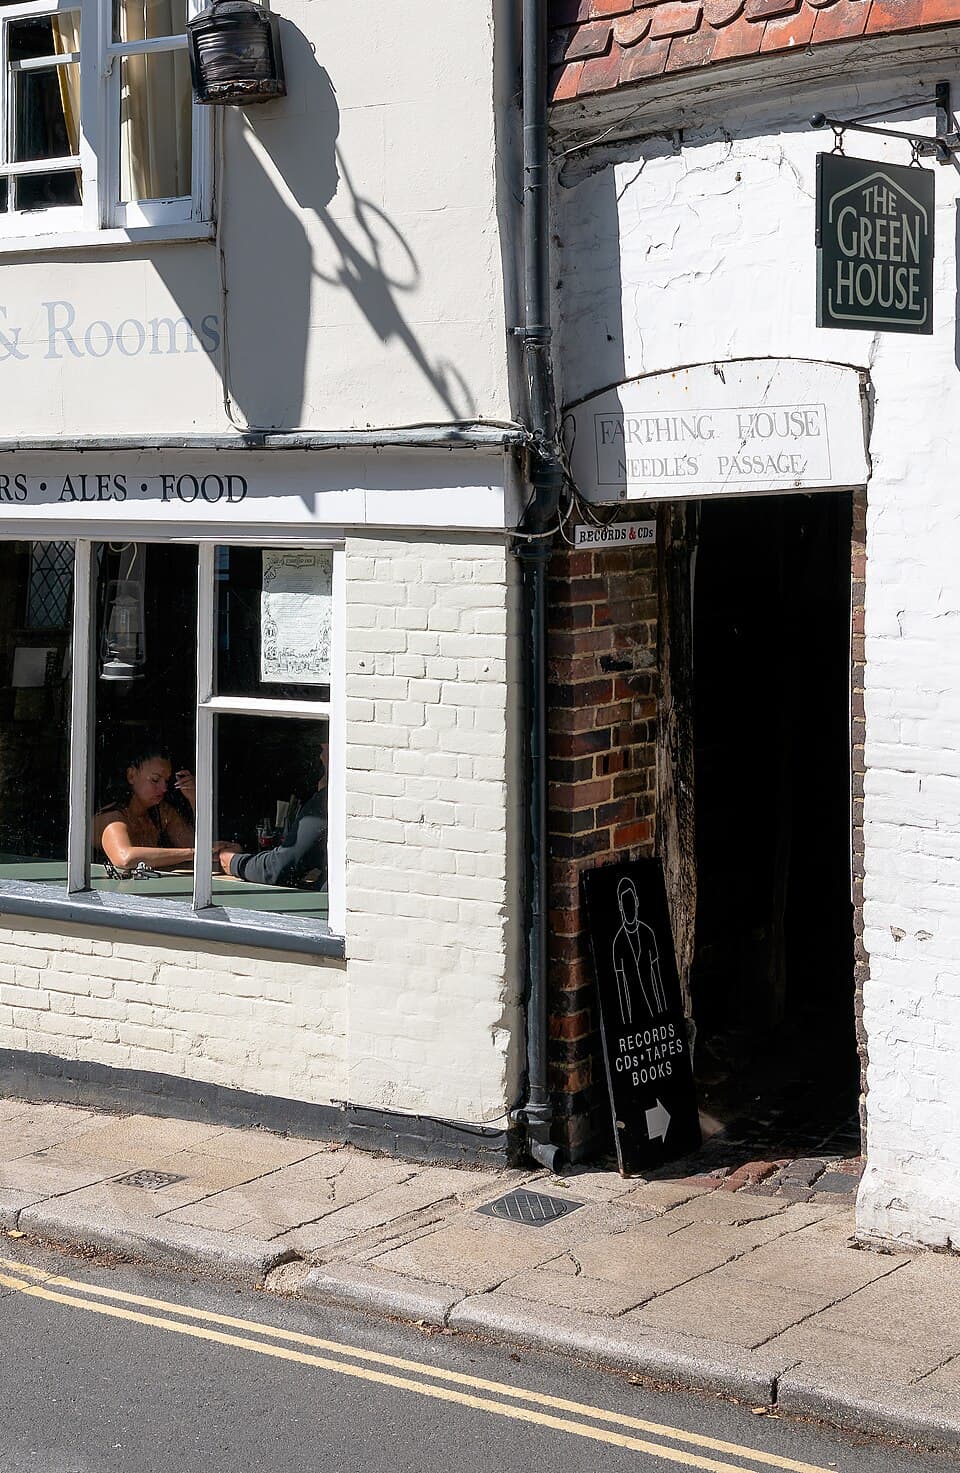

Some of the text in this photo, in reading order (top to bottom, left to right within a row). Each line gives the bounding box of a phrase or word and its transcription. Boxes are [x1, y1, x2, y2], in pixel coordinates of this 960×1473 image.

[862, 185, 897, 216] THE
[837, 206, 920, 264] GREEN
[836, 260, 920, 311] HOUSE
[41, 300, 221, 360] Rooms
[600, 410, 821, 445] FARTHING HOUSE
[717, 454, 802, 475] PASSAGE
[57, 473, 127, 502] ALES
[160, 473, 248, 504] FOOD
[580, 527, 653, 543] RECORDS & CDs
[619, 1023, 675, 1054] RECORDS
[632, 1061, 673, 1086] BOOKS
